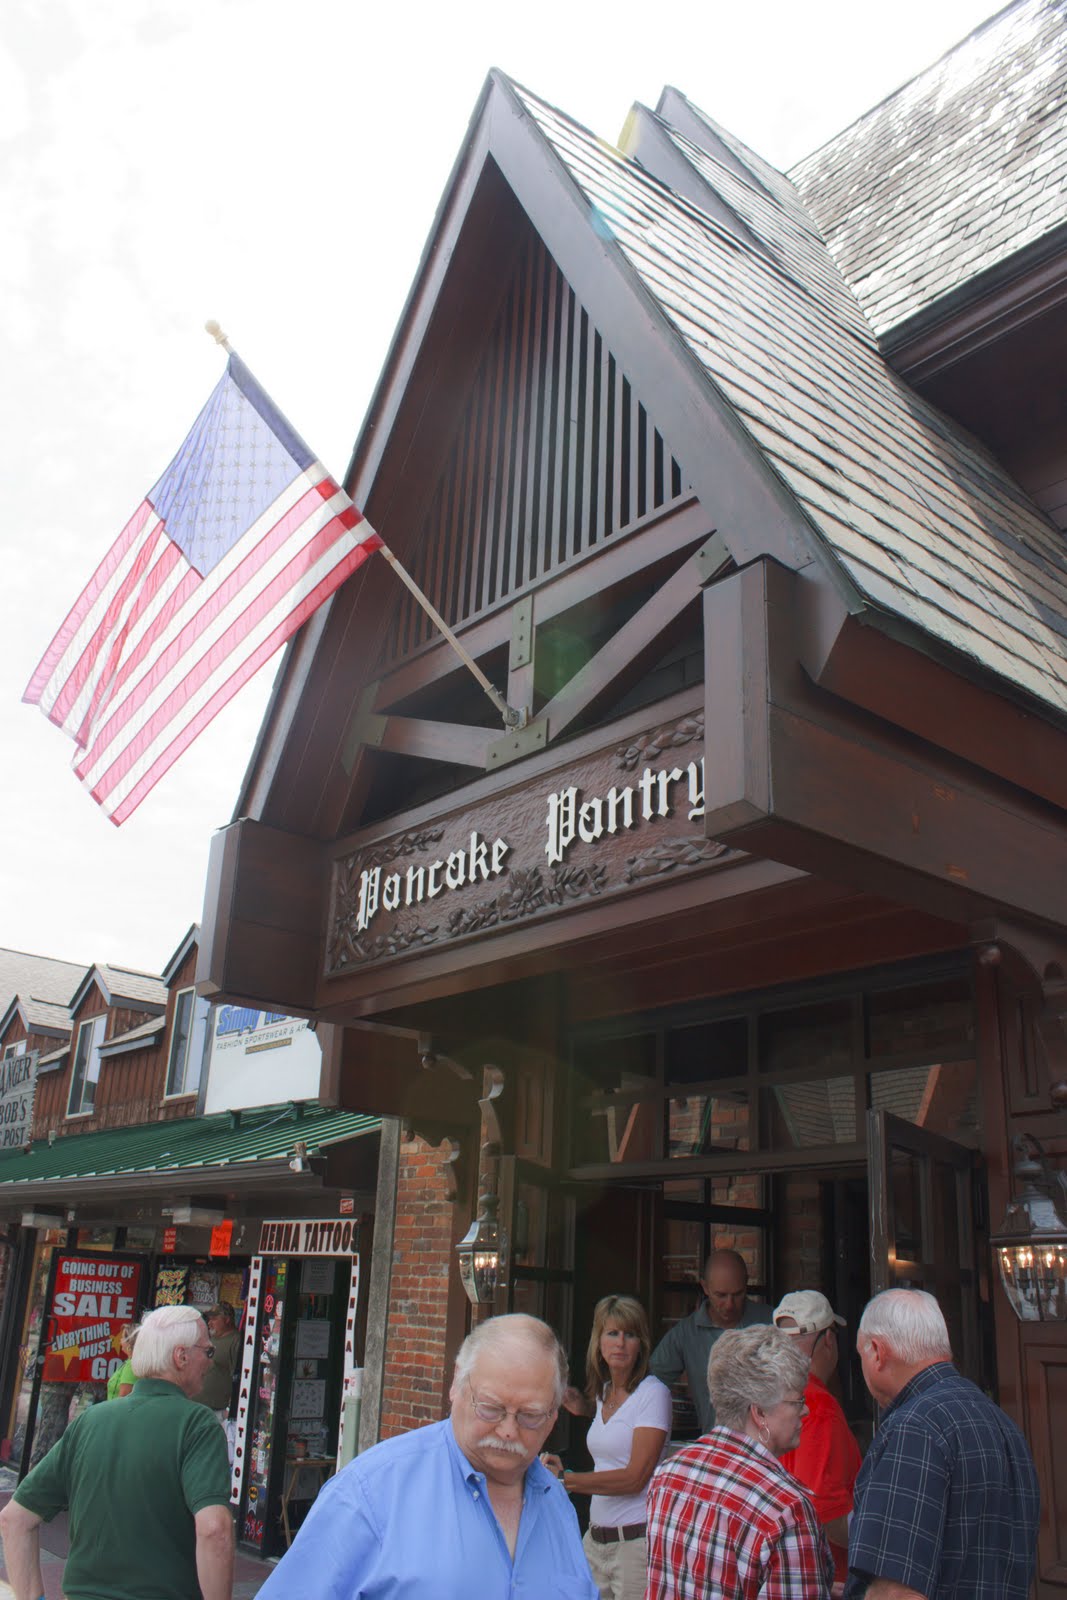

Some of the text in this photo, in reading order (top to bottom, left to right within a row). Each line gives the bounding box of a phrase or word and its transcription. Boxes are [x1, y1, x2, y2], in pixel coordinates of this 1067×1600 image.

[356, 757, 706, 932] Pancake Pantry
[216, 1039, 243, 1049] FASHION
[244, 1029, 287, 1044] SPORTSWEAR
[3, 1127, 25, 1146] POST
[260, 1223, 300, 1251] HENNA
[62, 1261, 134, 1278] GOING OUT OF
[69, 1279, 122, 1295] BUSINESS
[54, 1293, 133, 1319] SALE
[246, 1259, 260, 1346] HENNA
[52, 1322, 110, 1352] EVERYTHING
[79, 1340, 112, 1361] MUST
[91, 1357, 123, 1380] GO
[232, 1368, 250, 1499] TATTOOS
